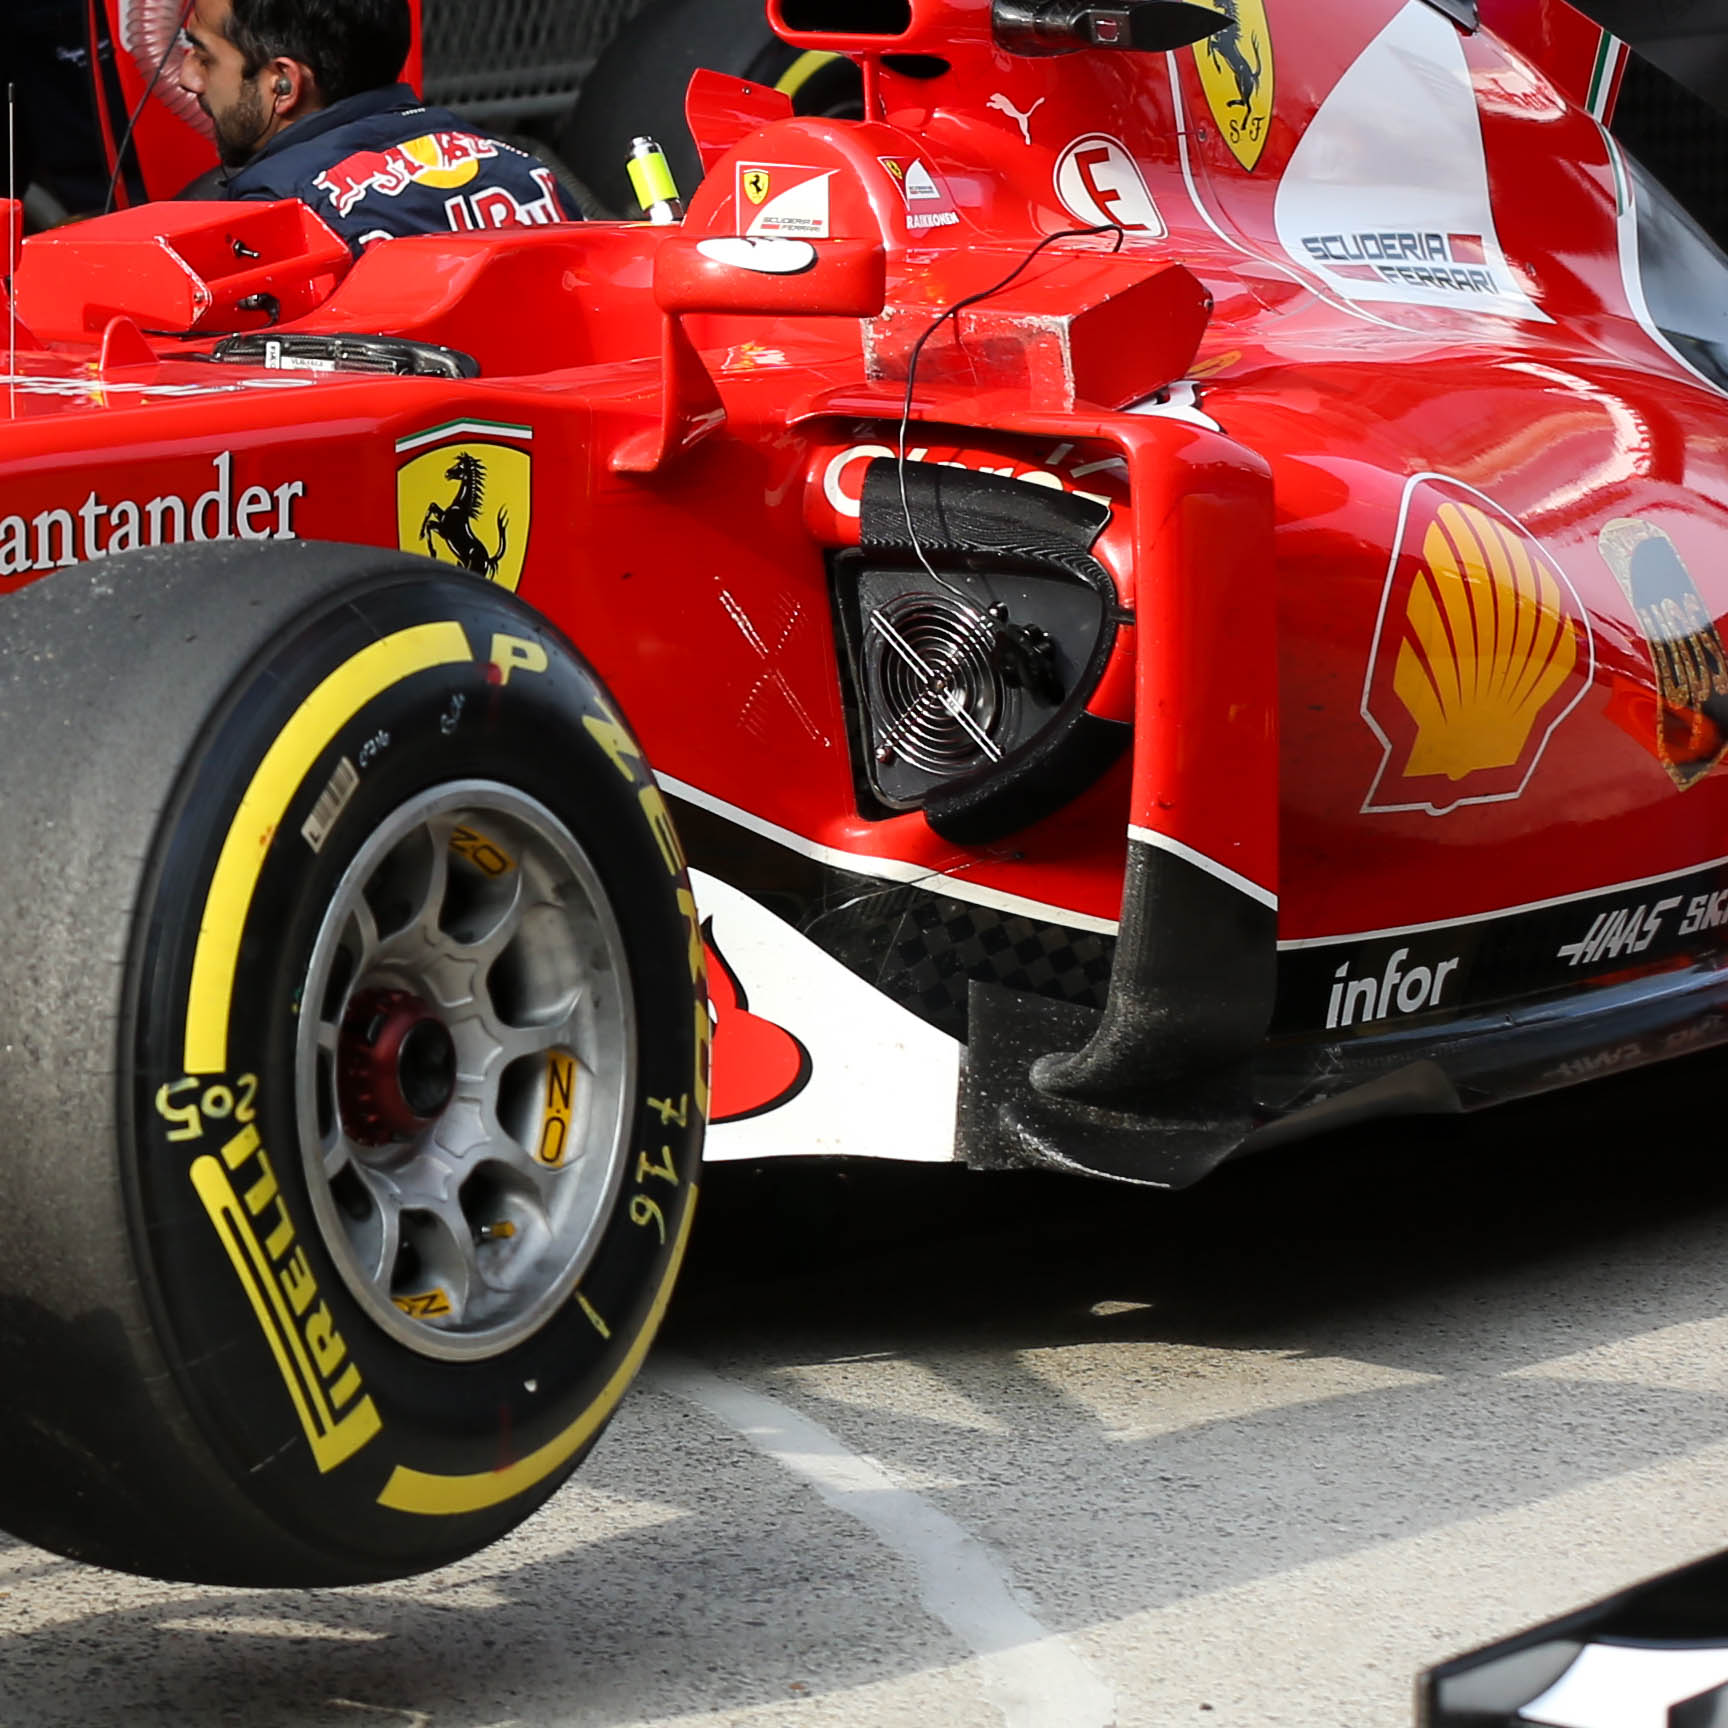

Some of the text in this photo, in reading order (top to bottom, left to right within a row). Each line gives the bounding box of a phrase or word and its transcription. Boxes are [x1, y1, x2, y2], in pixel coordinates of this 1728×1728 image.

[1301, 232, 1446, 262] SCUDERIA
[1376, 264, 1500, 295] FERRARI
[489, 632, 549, 686] P
[1557, 895, 1685, 966] HAAS
[1325, 946, 1460, 1030] infor
[189, 1122, 384, 1474] PIRELLI
